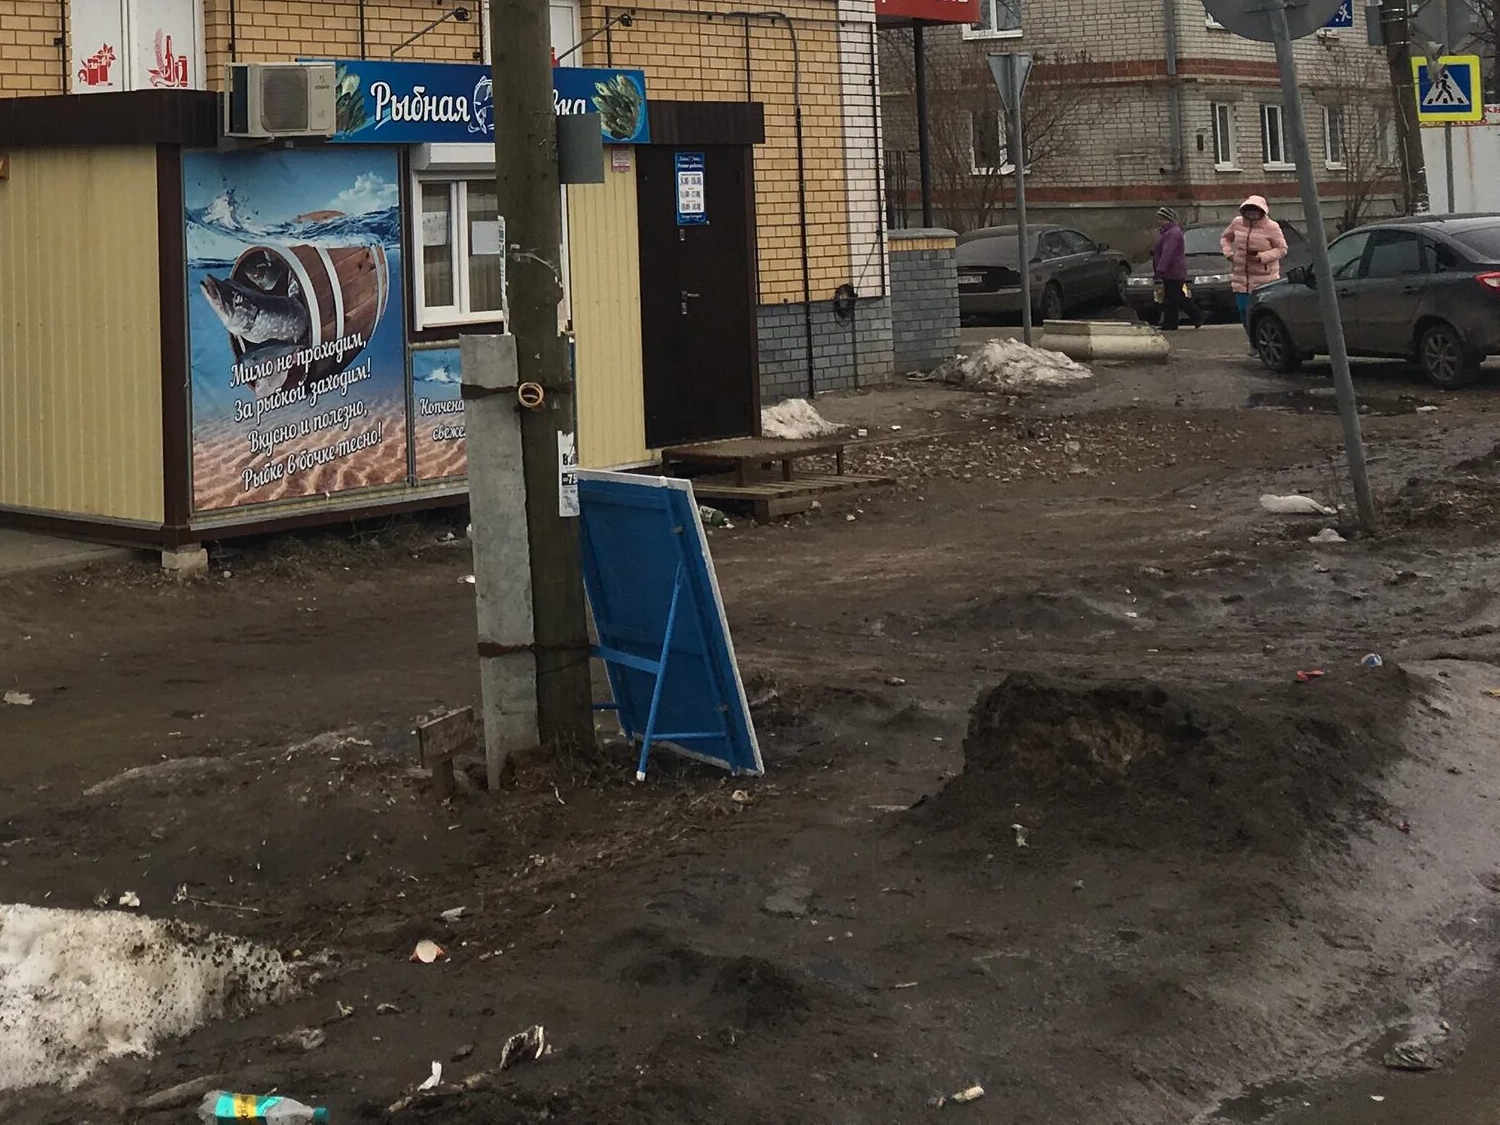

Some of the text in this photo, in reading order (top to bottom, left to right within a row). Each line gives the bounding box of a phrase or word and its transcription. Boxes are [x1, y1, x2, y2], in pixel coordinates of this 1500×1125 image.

[370, 81, 471, 128] Рыбная
[229, 331, 367, 388] Мимо не проходим,
[234, 358, 372, 425] За рыбкой заходим!
[419, 398, 465, 416] Копчена
[248, 400, 368, 456] Вкусно и полезно,
[432, 424, 466, 441] свеже
[242, 422, 383, 492] Рыбке в бочке тесно!
